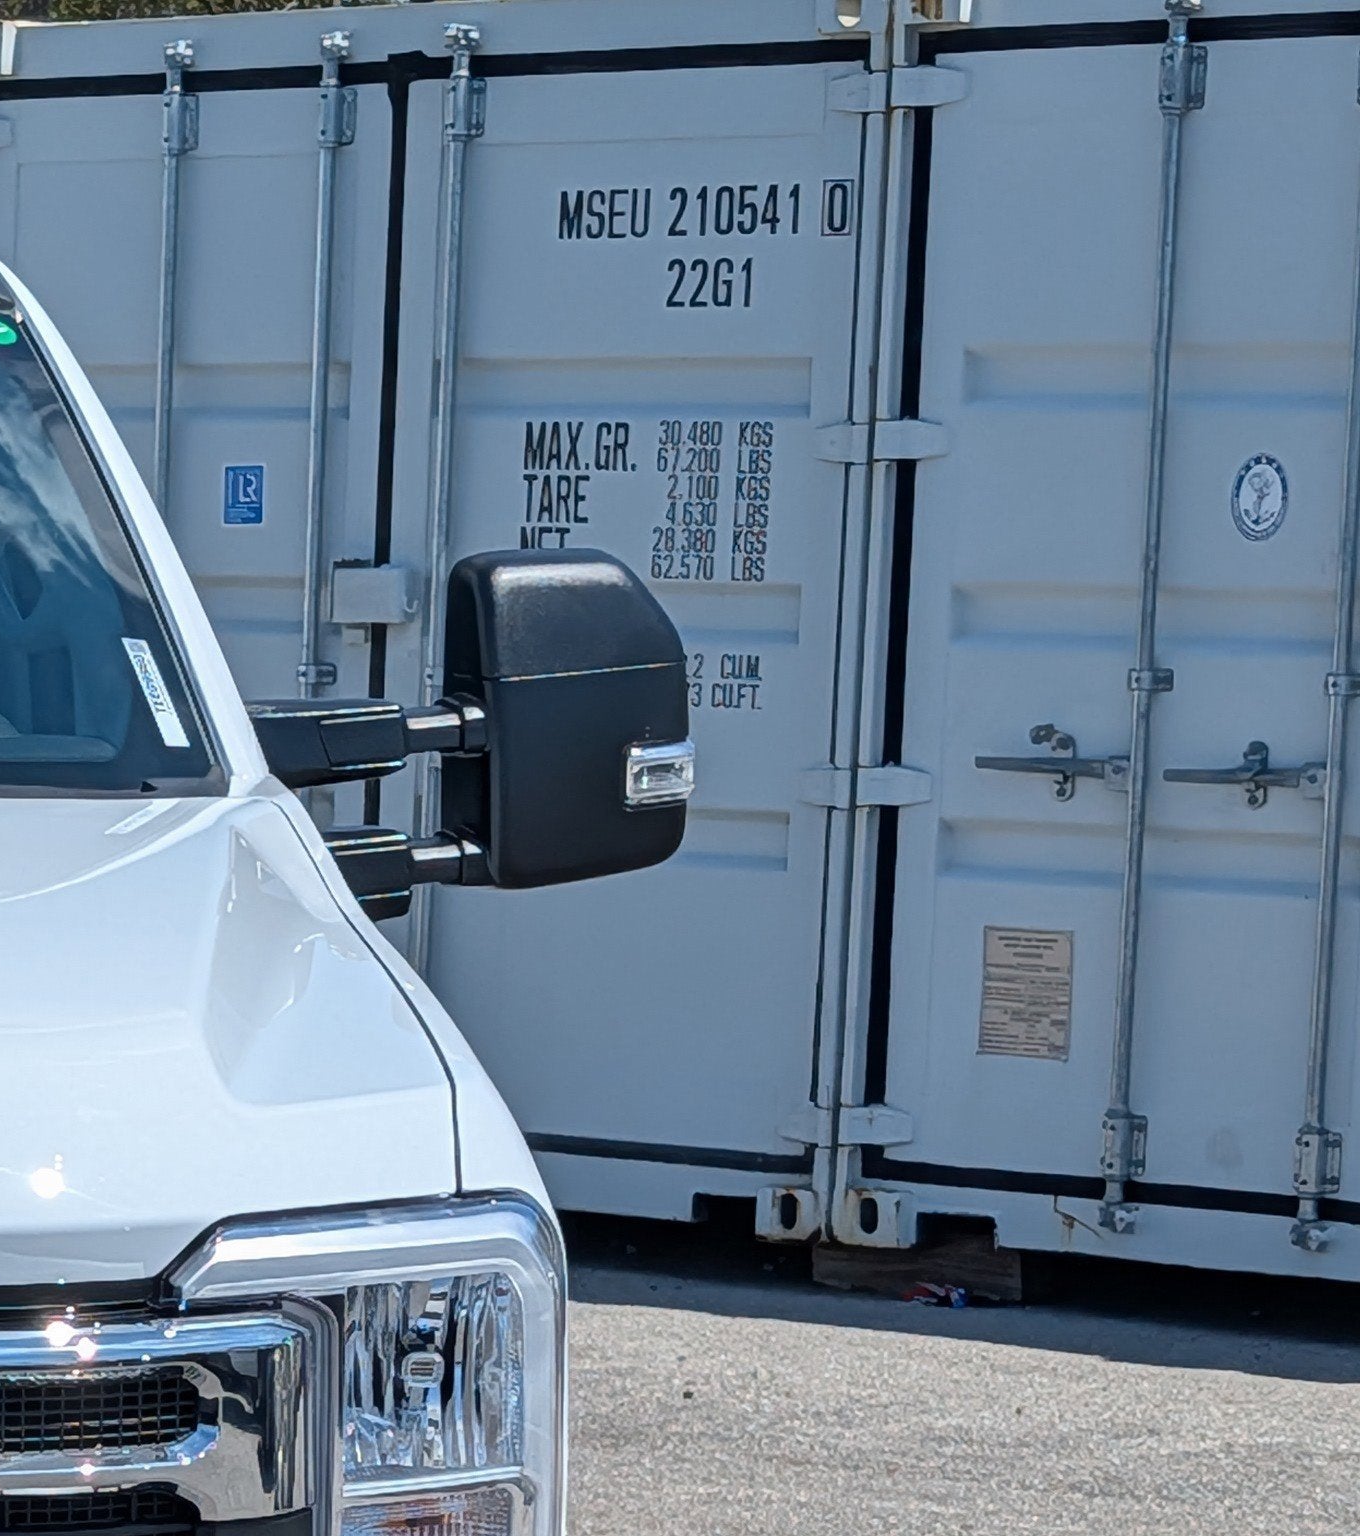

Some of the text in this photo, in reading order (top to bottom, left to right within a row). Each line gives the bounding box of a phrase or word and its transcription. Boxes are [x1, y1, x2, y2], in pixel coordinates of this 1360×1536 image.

[558, 182, 849, 239] MSEU 210541 0
[665, 257, 753, 307] 22G1
[523, 420, 774, 471] MAX.GR. 30.480 KGS
[737, 449, 772, 475] LBS
[523, 474, 591, 523] TARE
[735, 475, 771, 502] KGS
[733, 502, 769, 528] LBS
[651, 526, 716, 553] 28.380
[732, 528, 768, 555] KGS
[650, 553, 766, 582] 62.570 LBS
